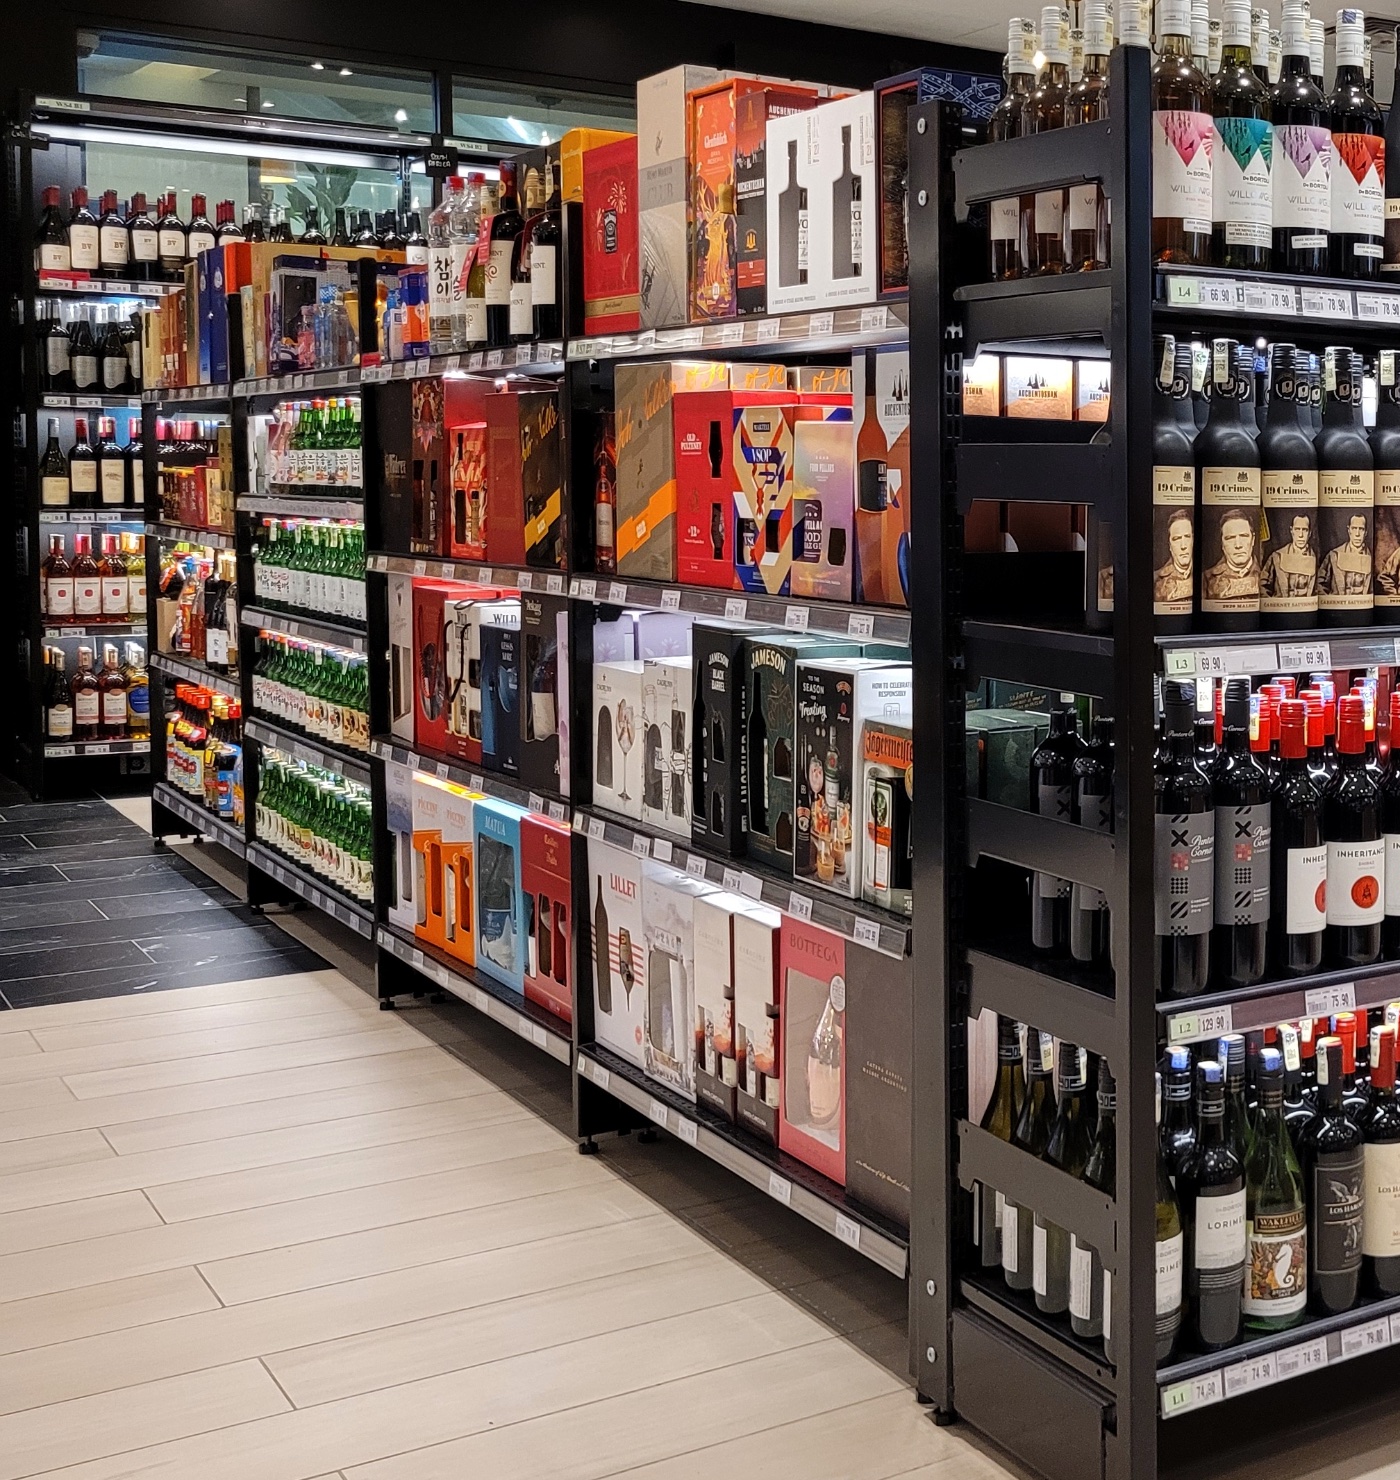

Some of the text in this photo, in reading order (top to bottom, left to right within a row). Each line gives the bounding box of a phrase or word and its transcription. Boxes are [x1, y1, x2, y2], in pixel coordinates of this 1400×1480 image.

[1389, 205, 1397, 213] 19
[1178, 287, 1230, 302] L4 66.90
[1271, 293, 1290, 307] 78.90
[1328, 298, 1346, 312] 78.90
[1382, 303, 1400, 316] 78.90
[752, 449, 772, 463] VSOP
[1158, 483, 1168, 491] 19
[1210, 483, 1220, 492] 19
[1266, 486, 1275, 495] 19
[1323, 486, 1333, 495] 19
[1382, 485, 1391, 493] 19
[708, 651, 730, 669] JAMESON
[750, 648, 787, 677] JAMESON
[1176, 656, 1221, 670] L3 69.90
[1306, 651, 1324, 664] 69.90
[712, 668, 725, 681] BLACK
[802, 682, 825, 694] SEASON
[610, 873, 637, 899] LILLET
[790, 933, 839, 965] BOTTEGA
[1331, 993, 1349, 1008] 75.90
[1179, 1016, 1224, 1033] L2 129.90
[1251, 1366, 1271, 1381] 74.90
[1195, 1384, 1216, 1399] 74.90
